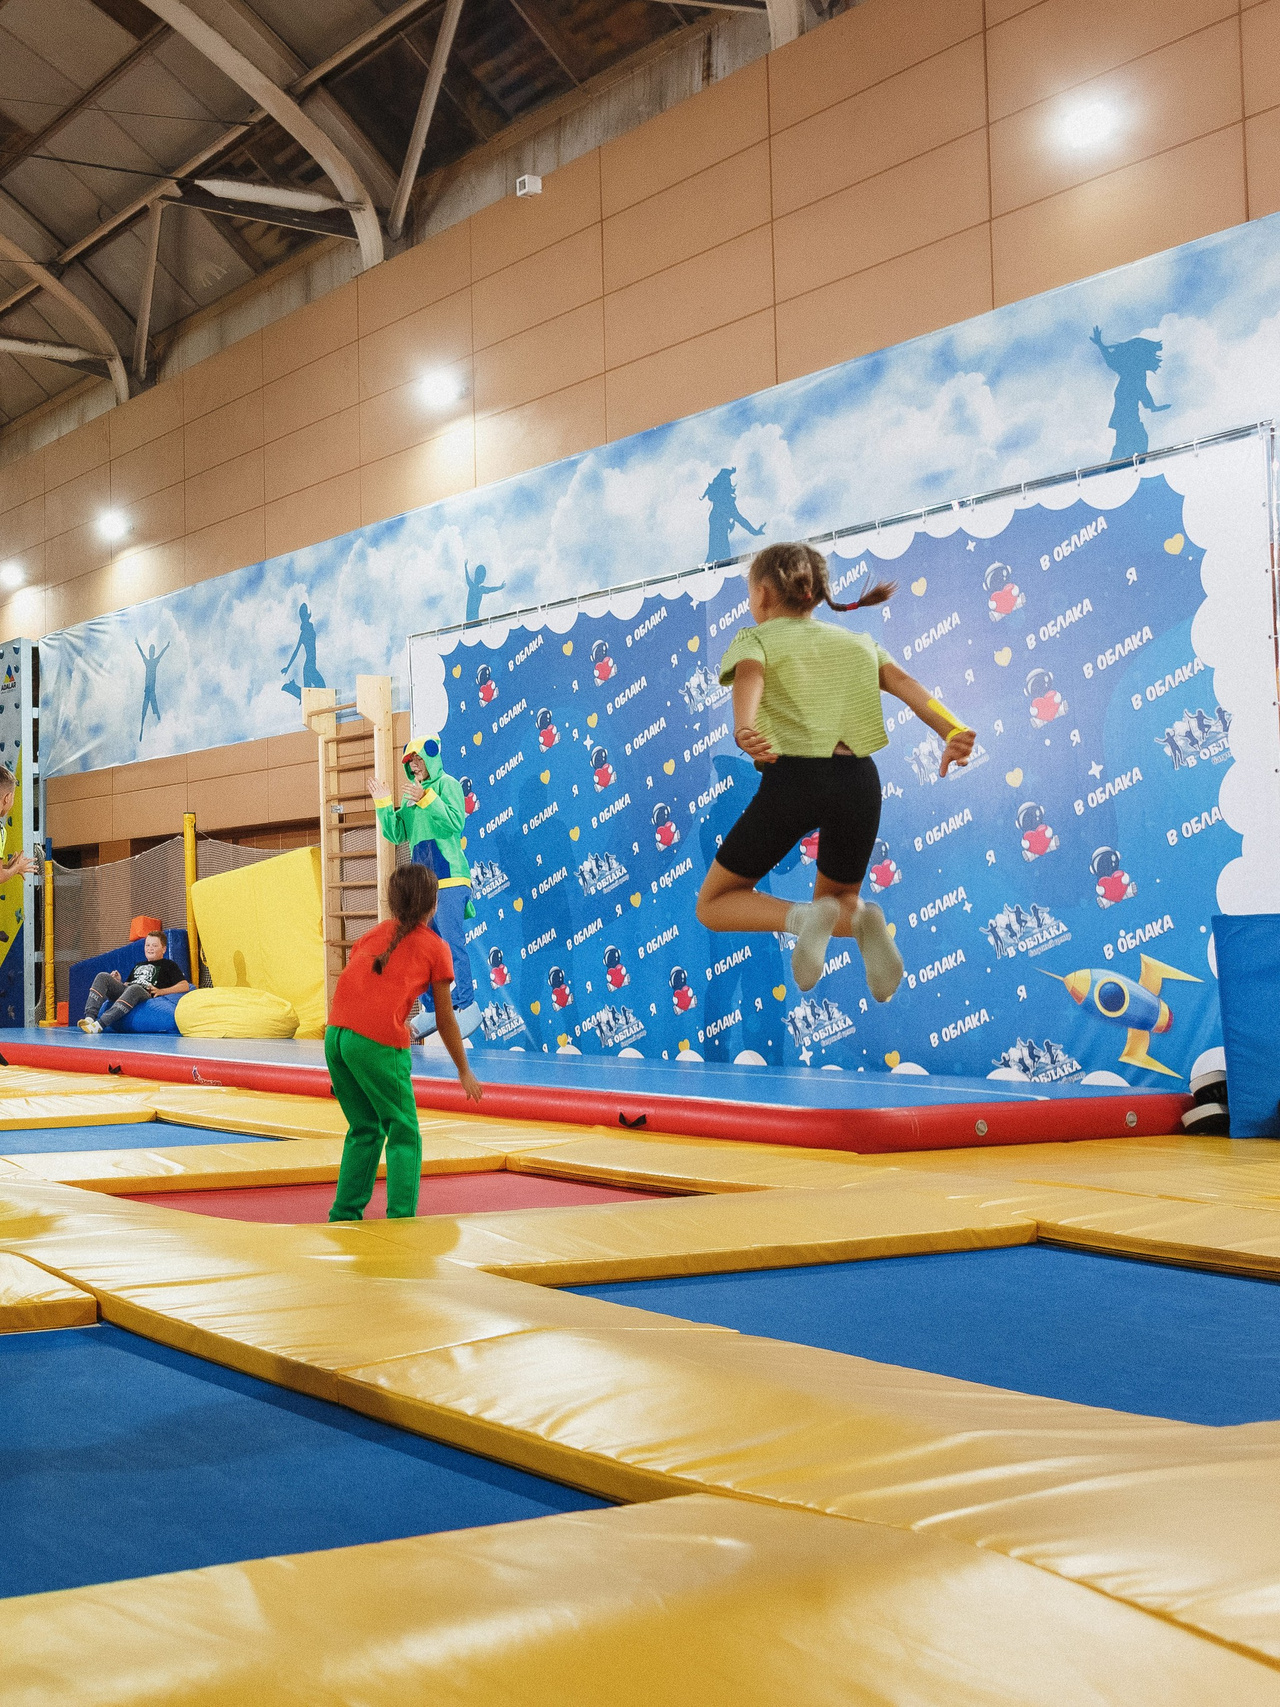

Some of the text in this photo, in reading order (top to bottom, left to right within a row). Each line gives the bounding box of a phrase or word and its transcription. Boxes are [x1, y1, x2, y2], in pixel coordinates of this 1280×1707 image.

[1040, 516, 1108, 571] В ОБЛАКА
[626, 606, 668, 648] В ОБЛАКА
[882, 606, 891, 622] Я
[1026, 598, 1093, 650] В ОБЛАКА
[508, 634, 544, 672] В ОБЛАКА
[671, 654, 678, 668] Я
[1082, 626, 1154, 679] В ОБЛАКА
[572, 680, 578, 693] Я
[964, 668, 974, 686] Я
[460, 700, 466, 713] Я
[606, 676, 648, 715] В ОБЛАКА
[492, 698, 528, 734] В ОБЛАКА
[886, 717, 896, 732] В
[994, 719, 1004, 736] Я
[572, 728, 579, 742] Я
[684, 723, 728, 763] В ОБЛАКА
[460, 746, 466, 758] Я
[489, 751, 524, 786] В ОБЛАКА
[572, 784, 578, 797] Я
[646, 776, 654, 790] Я
[689, 775, 734, 814] В ОБЛАКА
[479, 806, 514, 838] В ОБЛАКА
[522, 801, 559, 835] В ОБЛАКА
[914, 808, 973, 852] В ОБЛАКА
[536, 854, 542, 866] Я
[632, 842, 640, 856] Я
[986, 850, 996, 866] Я
[531, 887, 538, 900] В
[538, 866, 568, 894] ОБЛАКА
[590, 886, 596, 895] В
[596, 866, 627, 890] ОБЛАКА
[498, 909, 504, 921] Я
[615, 904, 623, 918] Я
[521, 928, 557, 960] В ОБЛАКА
[566, 918, 603, 951] В ОБЛАКА
[638, 925, 679, 959] В ОБЛАКА
[1007, 921, 1068, 958] В ОБЛАКА
[908, 949, 966, 989] В ОБЛАКА
[586, 981, 593, 994] Я
[1017, 985, 1027, 1002] Я
[650, 1003, 657, 1017] Я
[755, 998, 763, 1012] Я
[859, 998, 868, 1014] Я
[574, 1025, 580, 1037] В
[698, 1009, 742, 1043] В ОБЛАКА
[812, 1016, 853, 1042] ОБЛАКА
[929, 1008, 990, 1048] В ОБЛАКА
